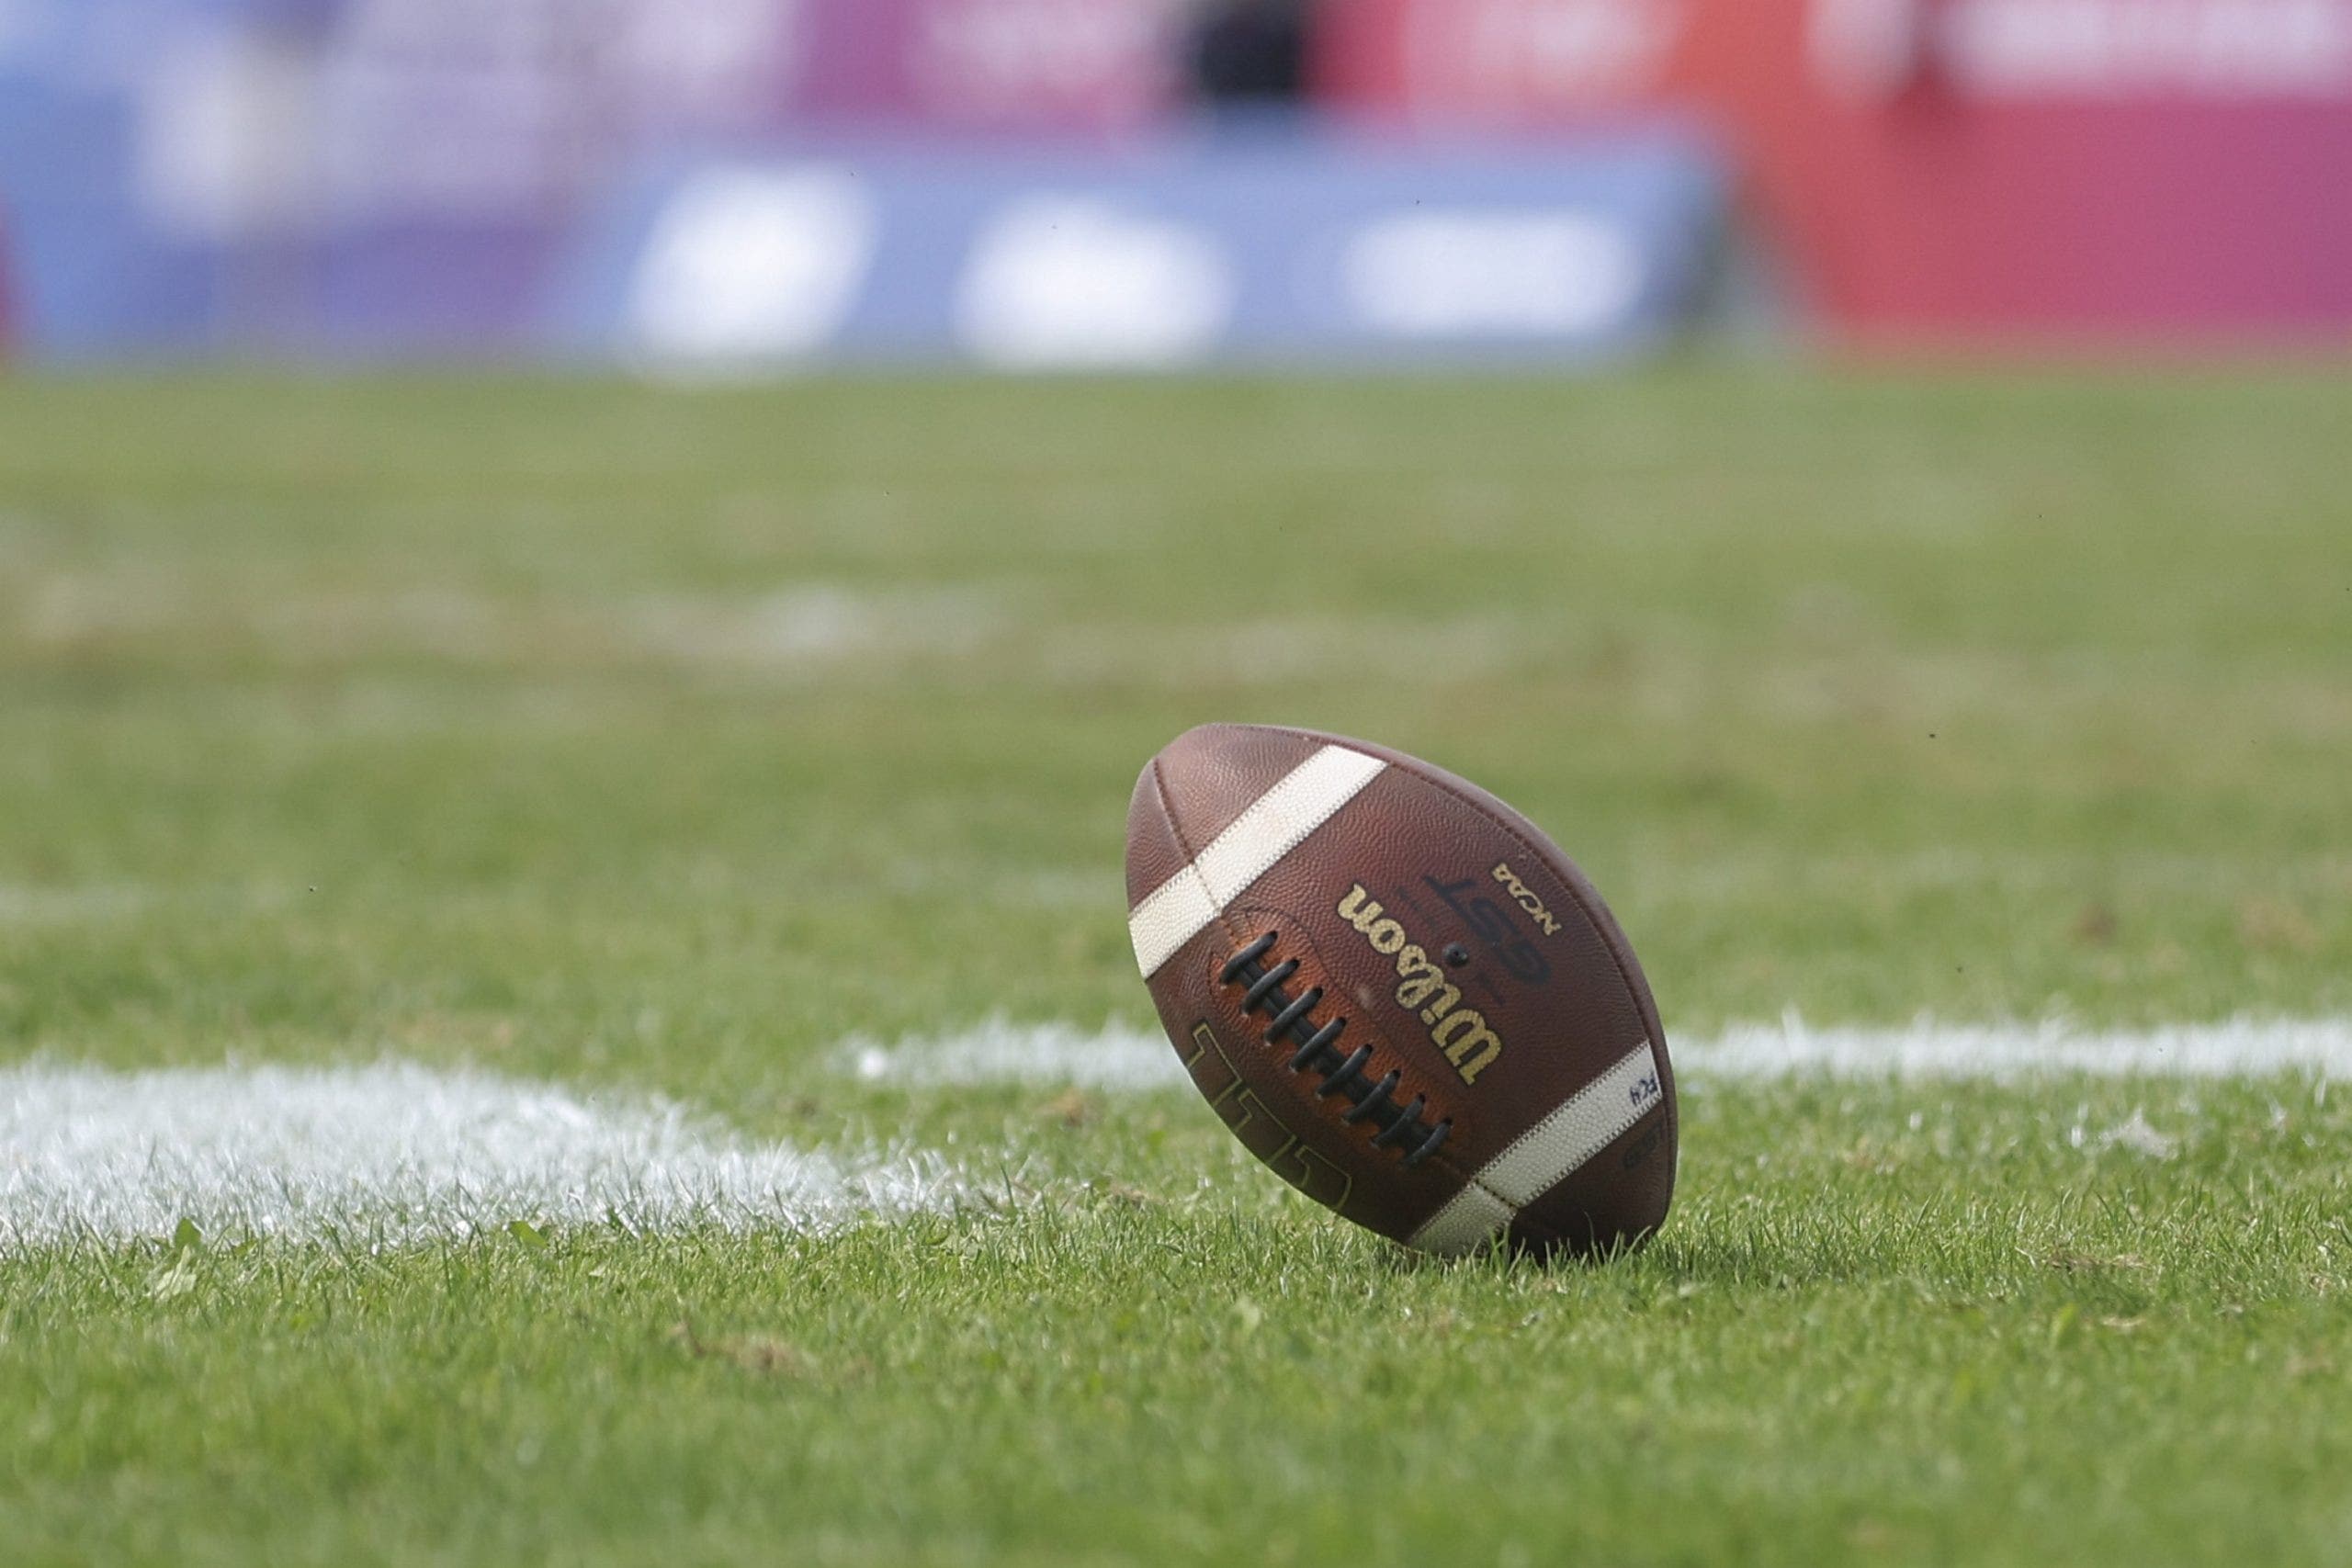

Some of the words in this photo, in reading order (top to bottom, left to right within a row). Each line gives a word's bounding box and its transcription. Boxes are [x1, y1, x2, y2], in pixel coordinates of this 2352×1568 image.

[1423, 875, 1553, 985] GST
[1491, 862, 1562, 936] NCAA
[1337, 882, 1503, 1086] Wilson
